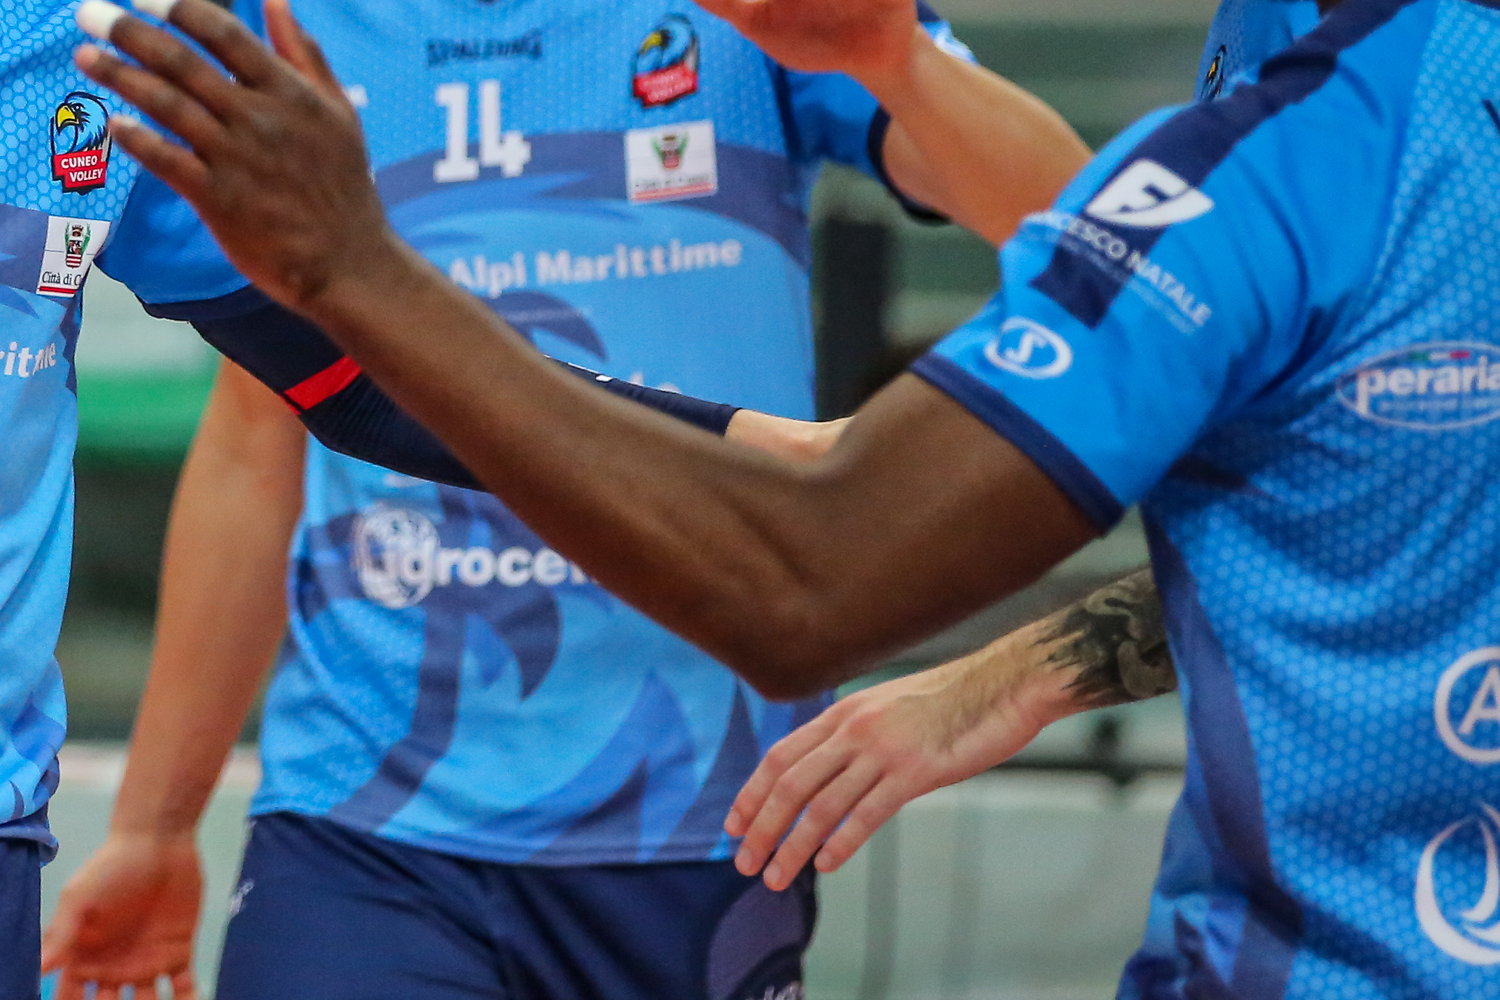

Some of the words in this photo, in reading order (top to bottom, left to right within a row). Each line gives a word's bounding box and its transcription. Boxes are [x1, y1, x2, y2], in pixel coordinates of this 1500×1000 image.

[433, 79, 531, 183] 14
[60, 155, 99, 170] CUNEO
[69, 168, 104, 183] VOLLEY
[449, 250, 528, 298] Alpi
[535, 238, 743, 285] Marittime
[41, 271, 61, 284] Città
[62, 273, 73, 285] di
